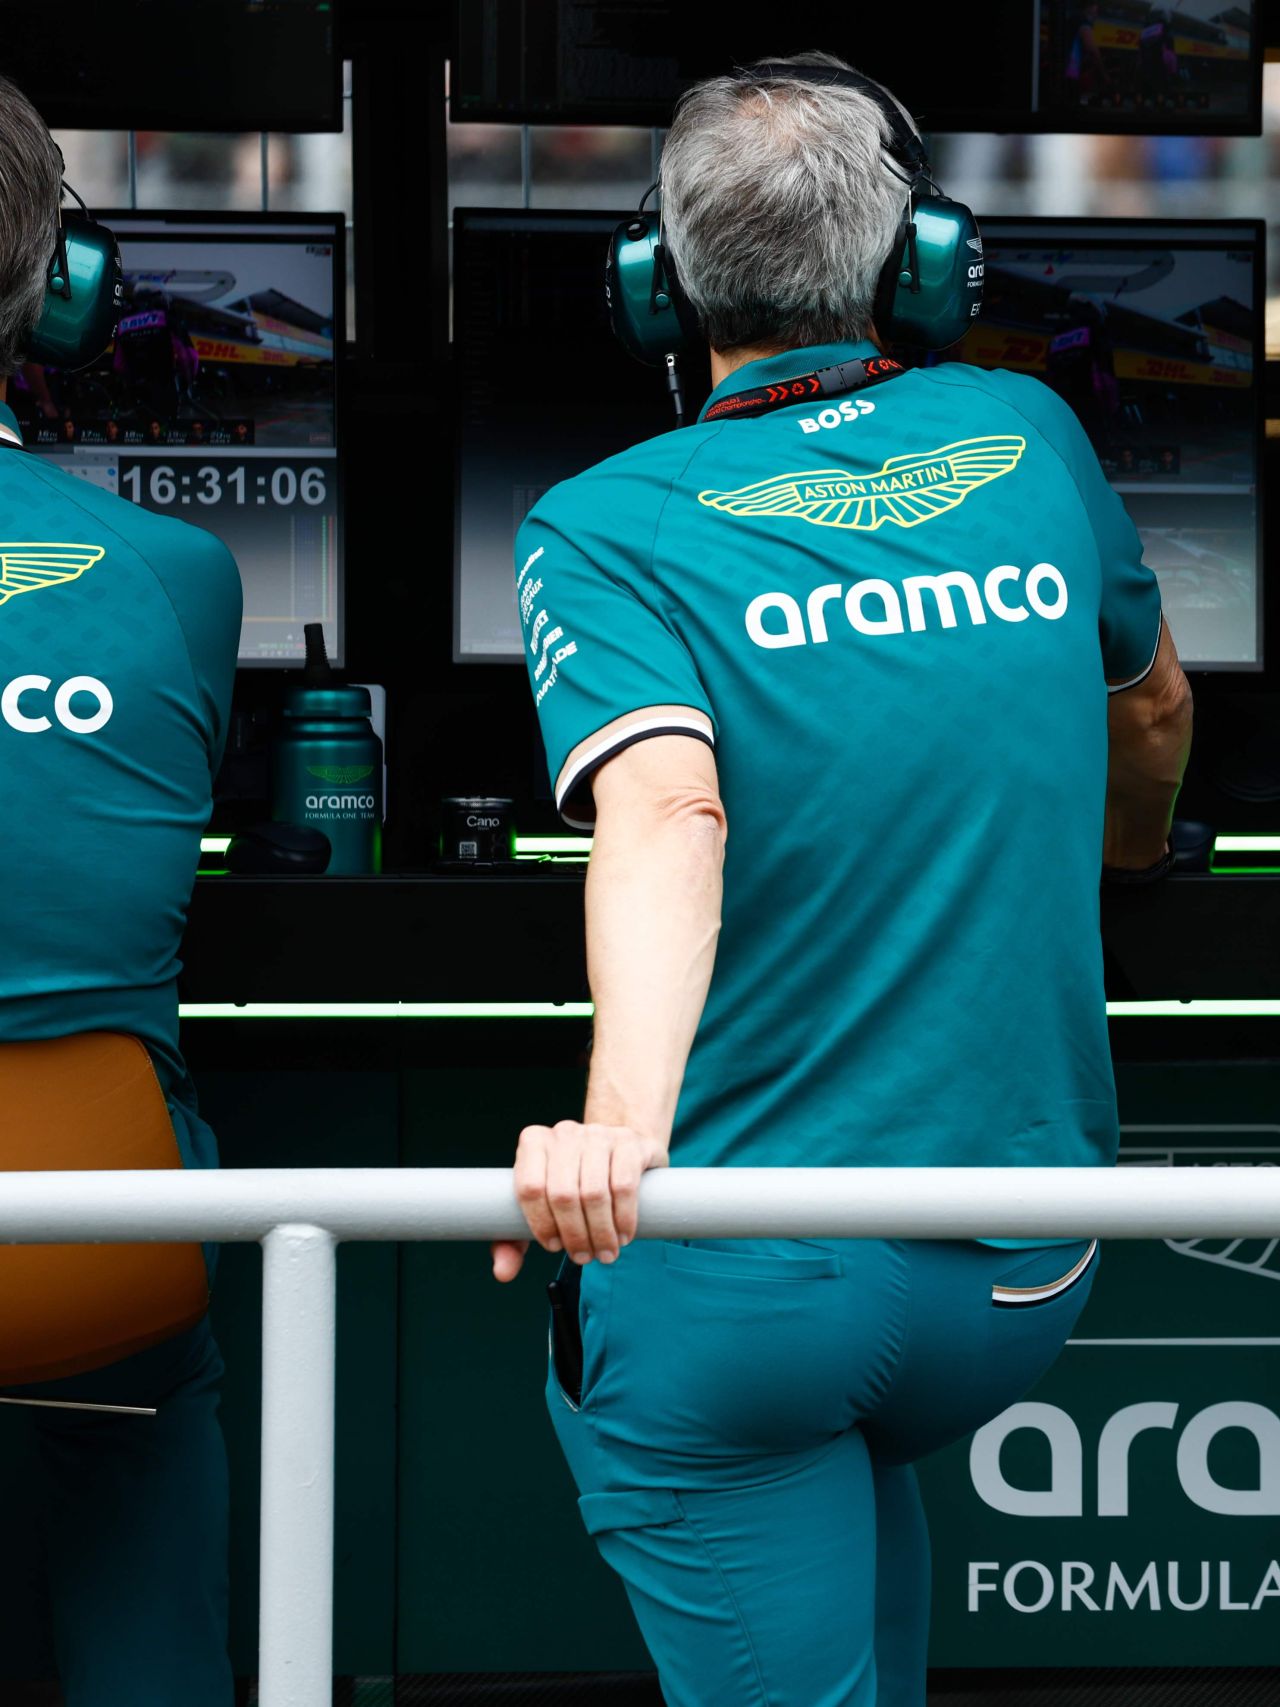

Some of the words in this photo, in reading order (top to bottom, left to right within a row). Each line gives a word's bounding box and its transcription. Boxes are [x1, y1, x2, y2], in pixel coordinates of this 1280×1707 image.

[797, 399, 876, 434] BOSS
[122, 465, 327, 505] 16:31:06
[803, 479, 867, 501] ASTON
[870, 463, 949, 494] MARTIN
[744, 562, 1069, 650] aramco
[305, 795, 375, 809] aramco
[305, 811, 341, 820] FORMULA
